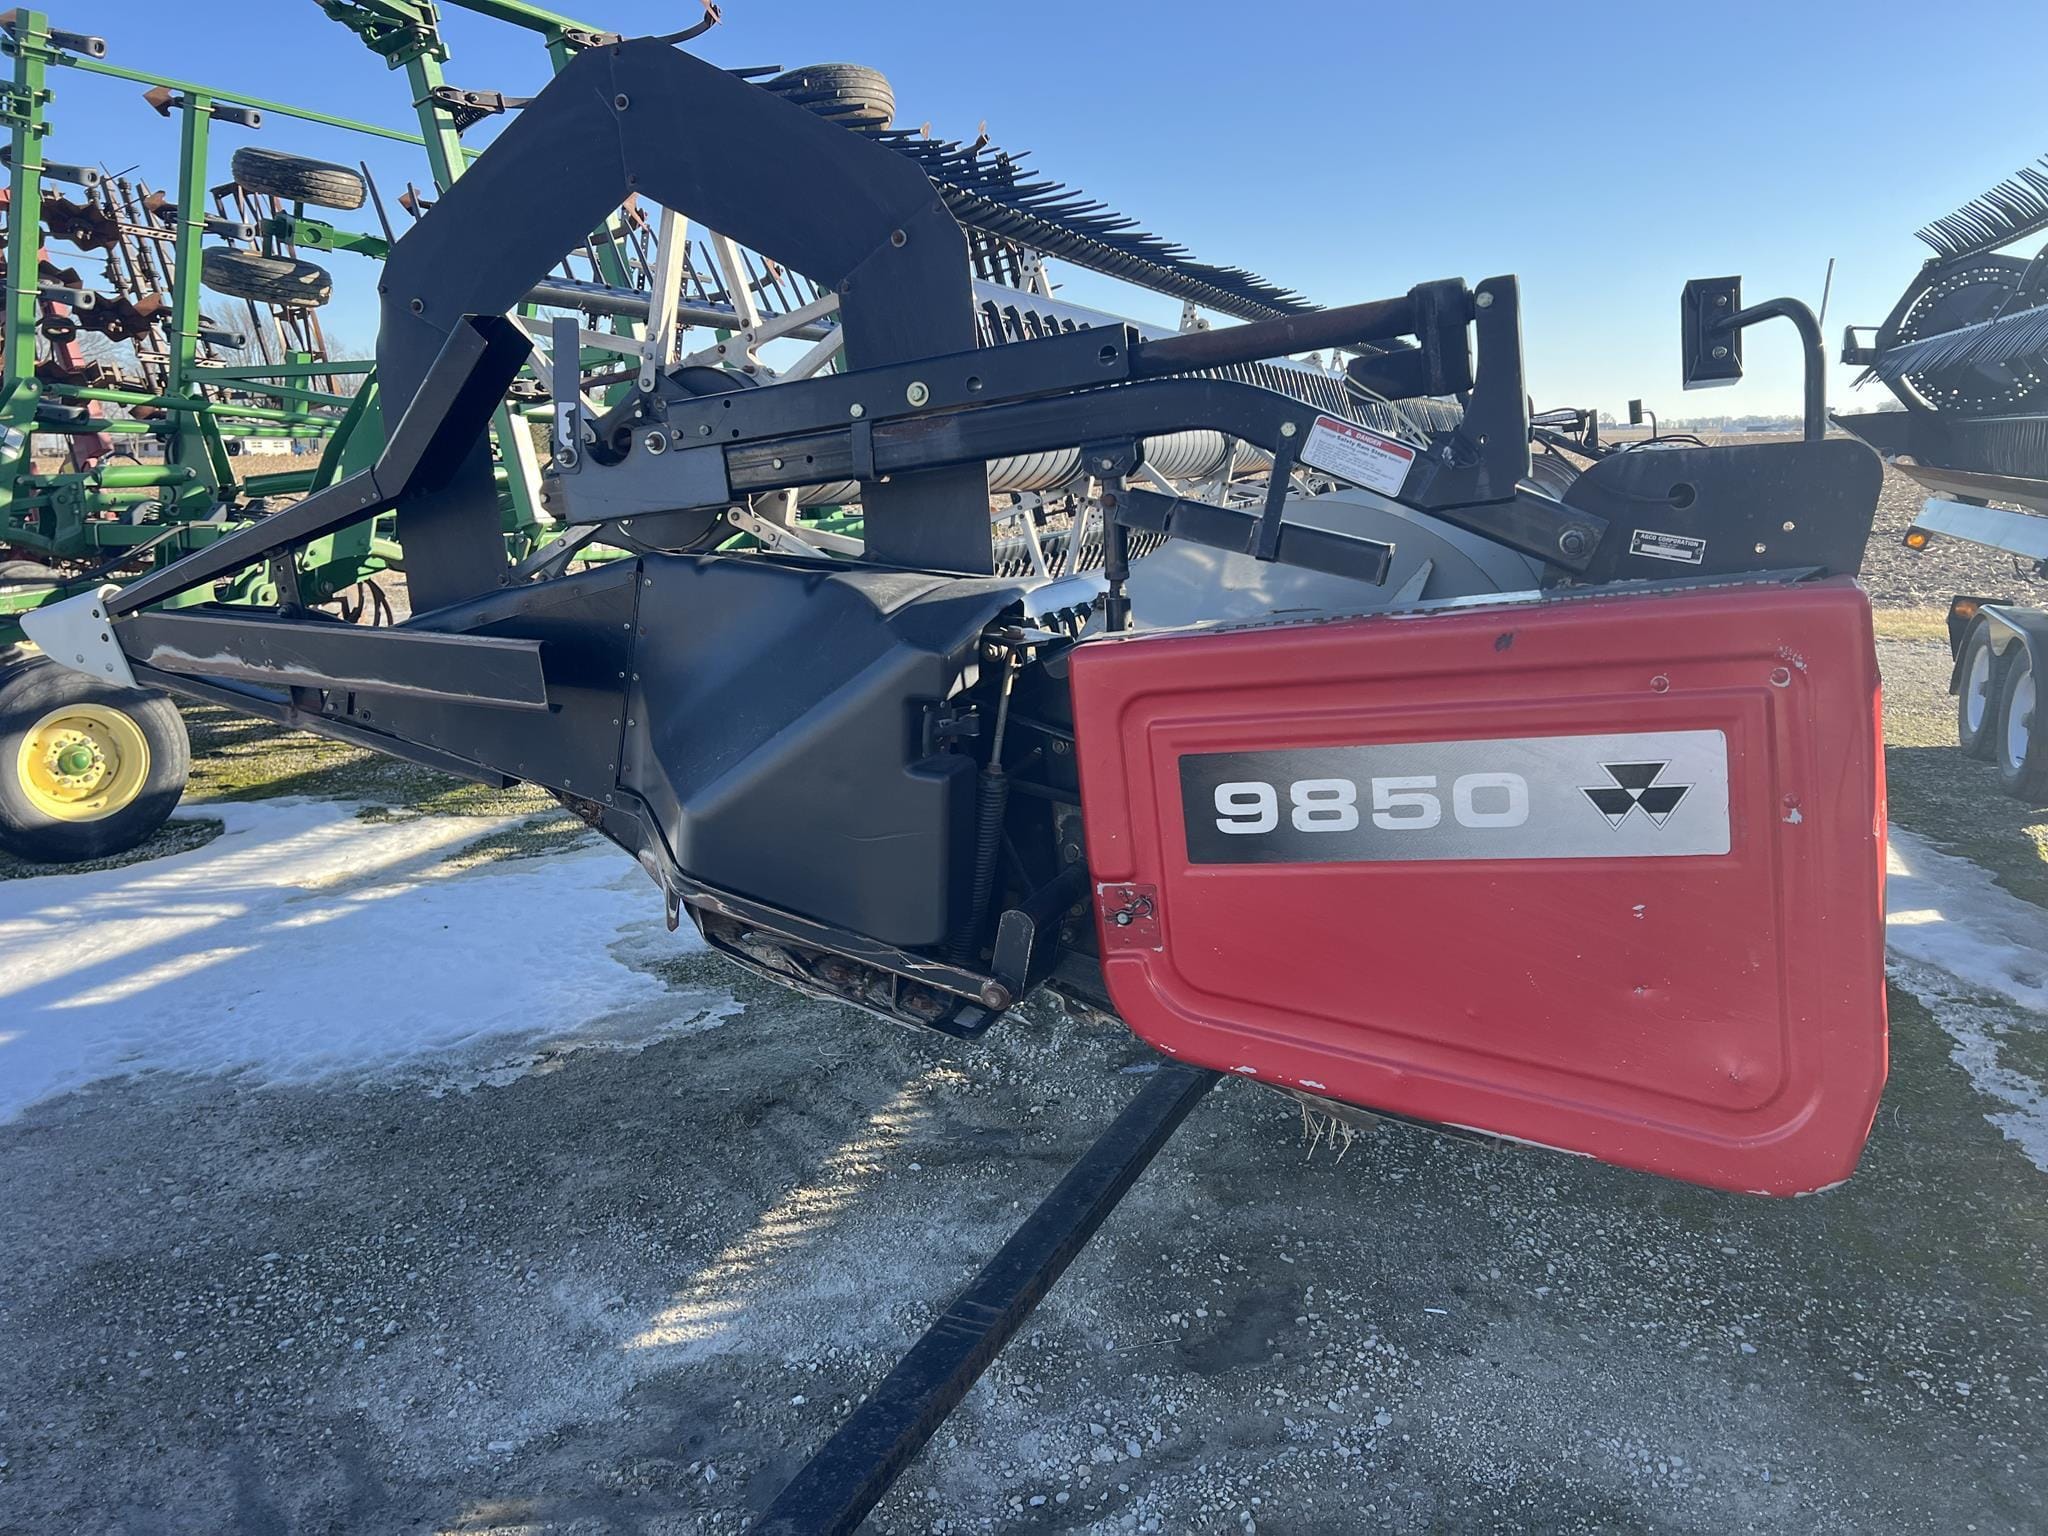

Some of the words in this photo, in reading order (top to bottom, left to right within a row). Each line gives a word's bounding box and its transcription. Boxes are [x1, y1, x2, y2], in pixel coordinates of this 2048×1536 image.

[1337, 435, 1356, 446] Safety
[1356, 441, 1370, 451] Ram
[1371, 447, 1388, 459] Stops
[1355, 432, 1382, 447] DANGER
[1640, 533, 1657, 541] AGCO
[1658, 536, 1699, 547] CORPORATION
[1213, 772, 1531, 835] 9850
